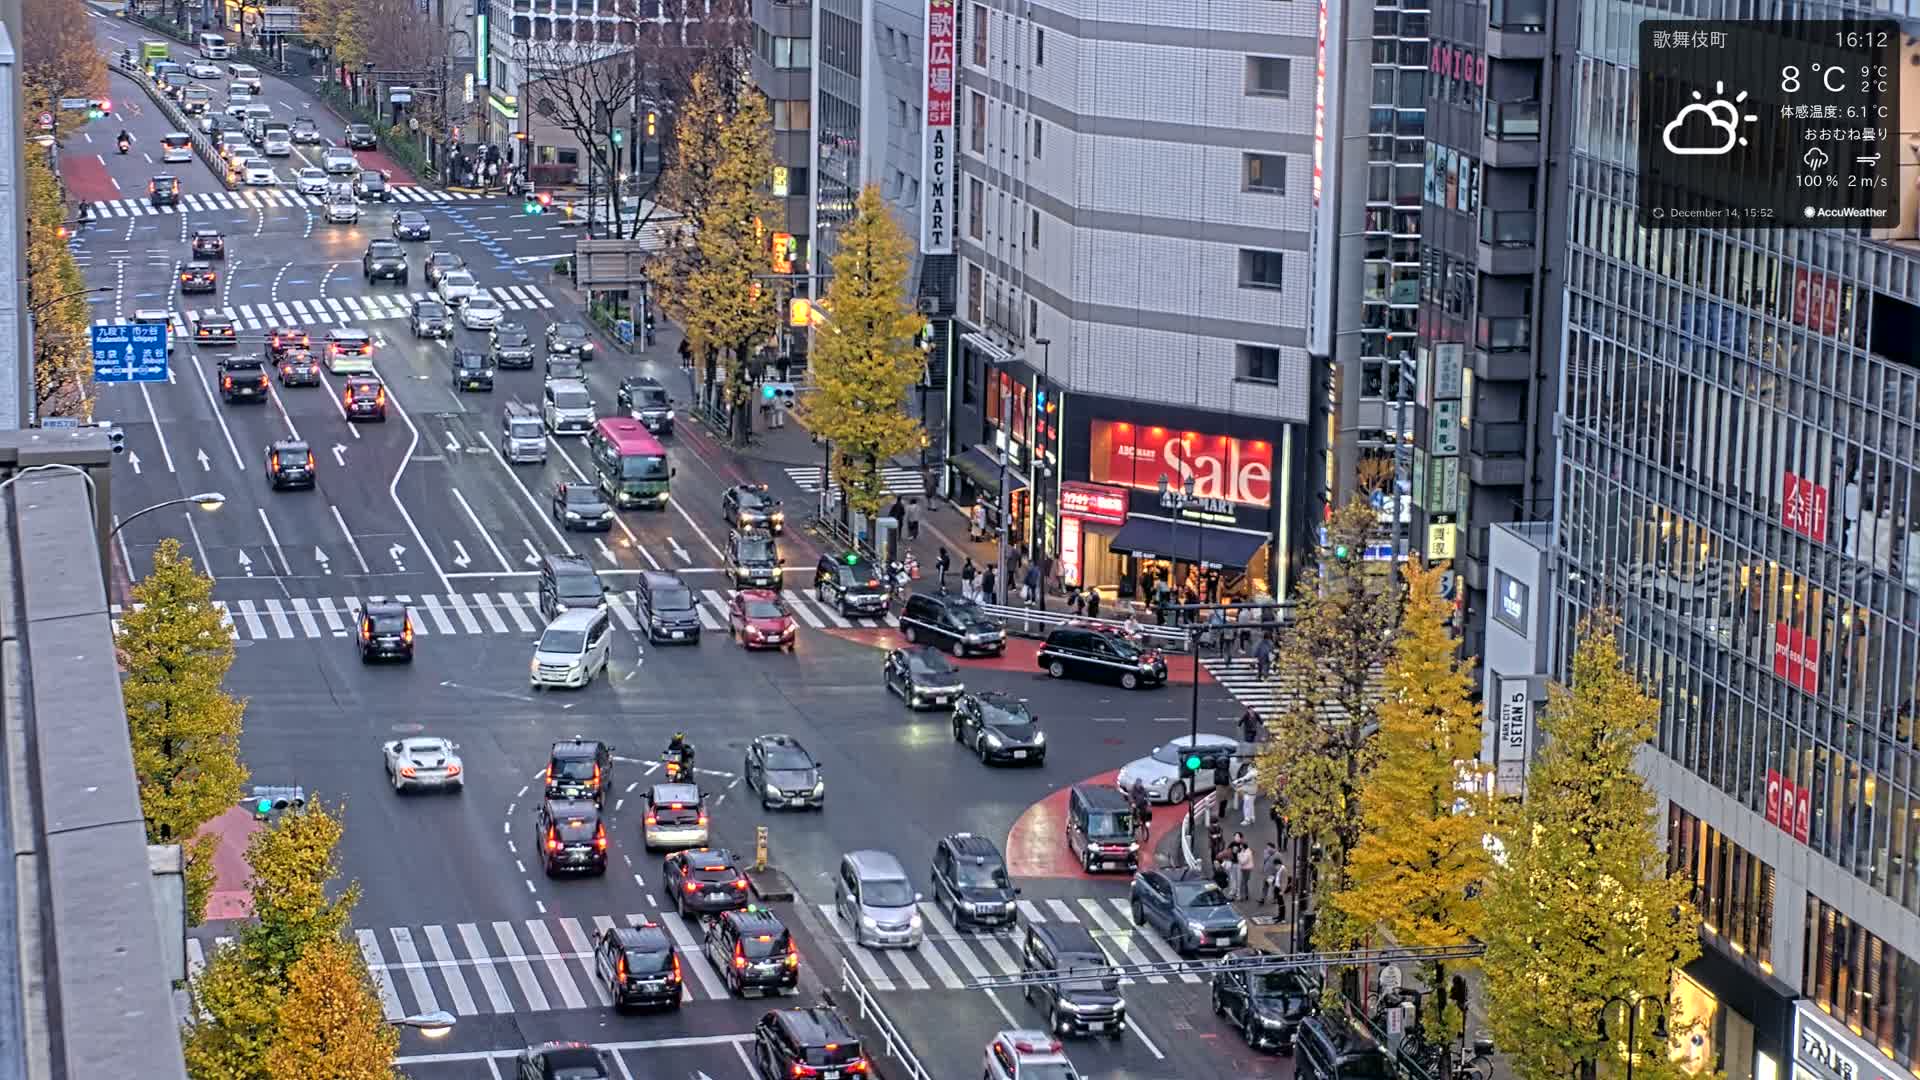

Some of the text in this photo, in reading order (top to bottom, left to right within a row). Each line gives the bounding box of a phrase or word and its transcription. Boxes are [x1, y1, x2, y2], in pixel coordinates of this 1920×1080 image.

[930, 12, 953, 94] 歌広場
[1431, 47, 1485, 86] AMIGO
[929, 100, 951, 111] 受付
[929, 111, 951, 122] 5F
[98, 327, 128, 336] 九段下
[1163, 437, 1271, 502] Sale
[1787, 483, 1823, 533] 会計
[1432, 527, 1445, 555] 買取
[1502, 703, 1511, 741] PARK CITY
[1510, 692, 1525, 748] ISETAN 5
[1768, 781, 1806, 828] CPA
